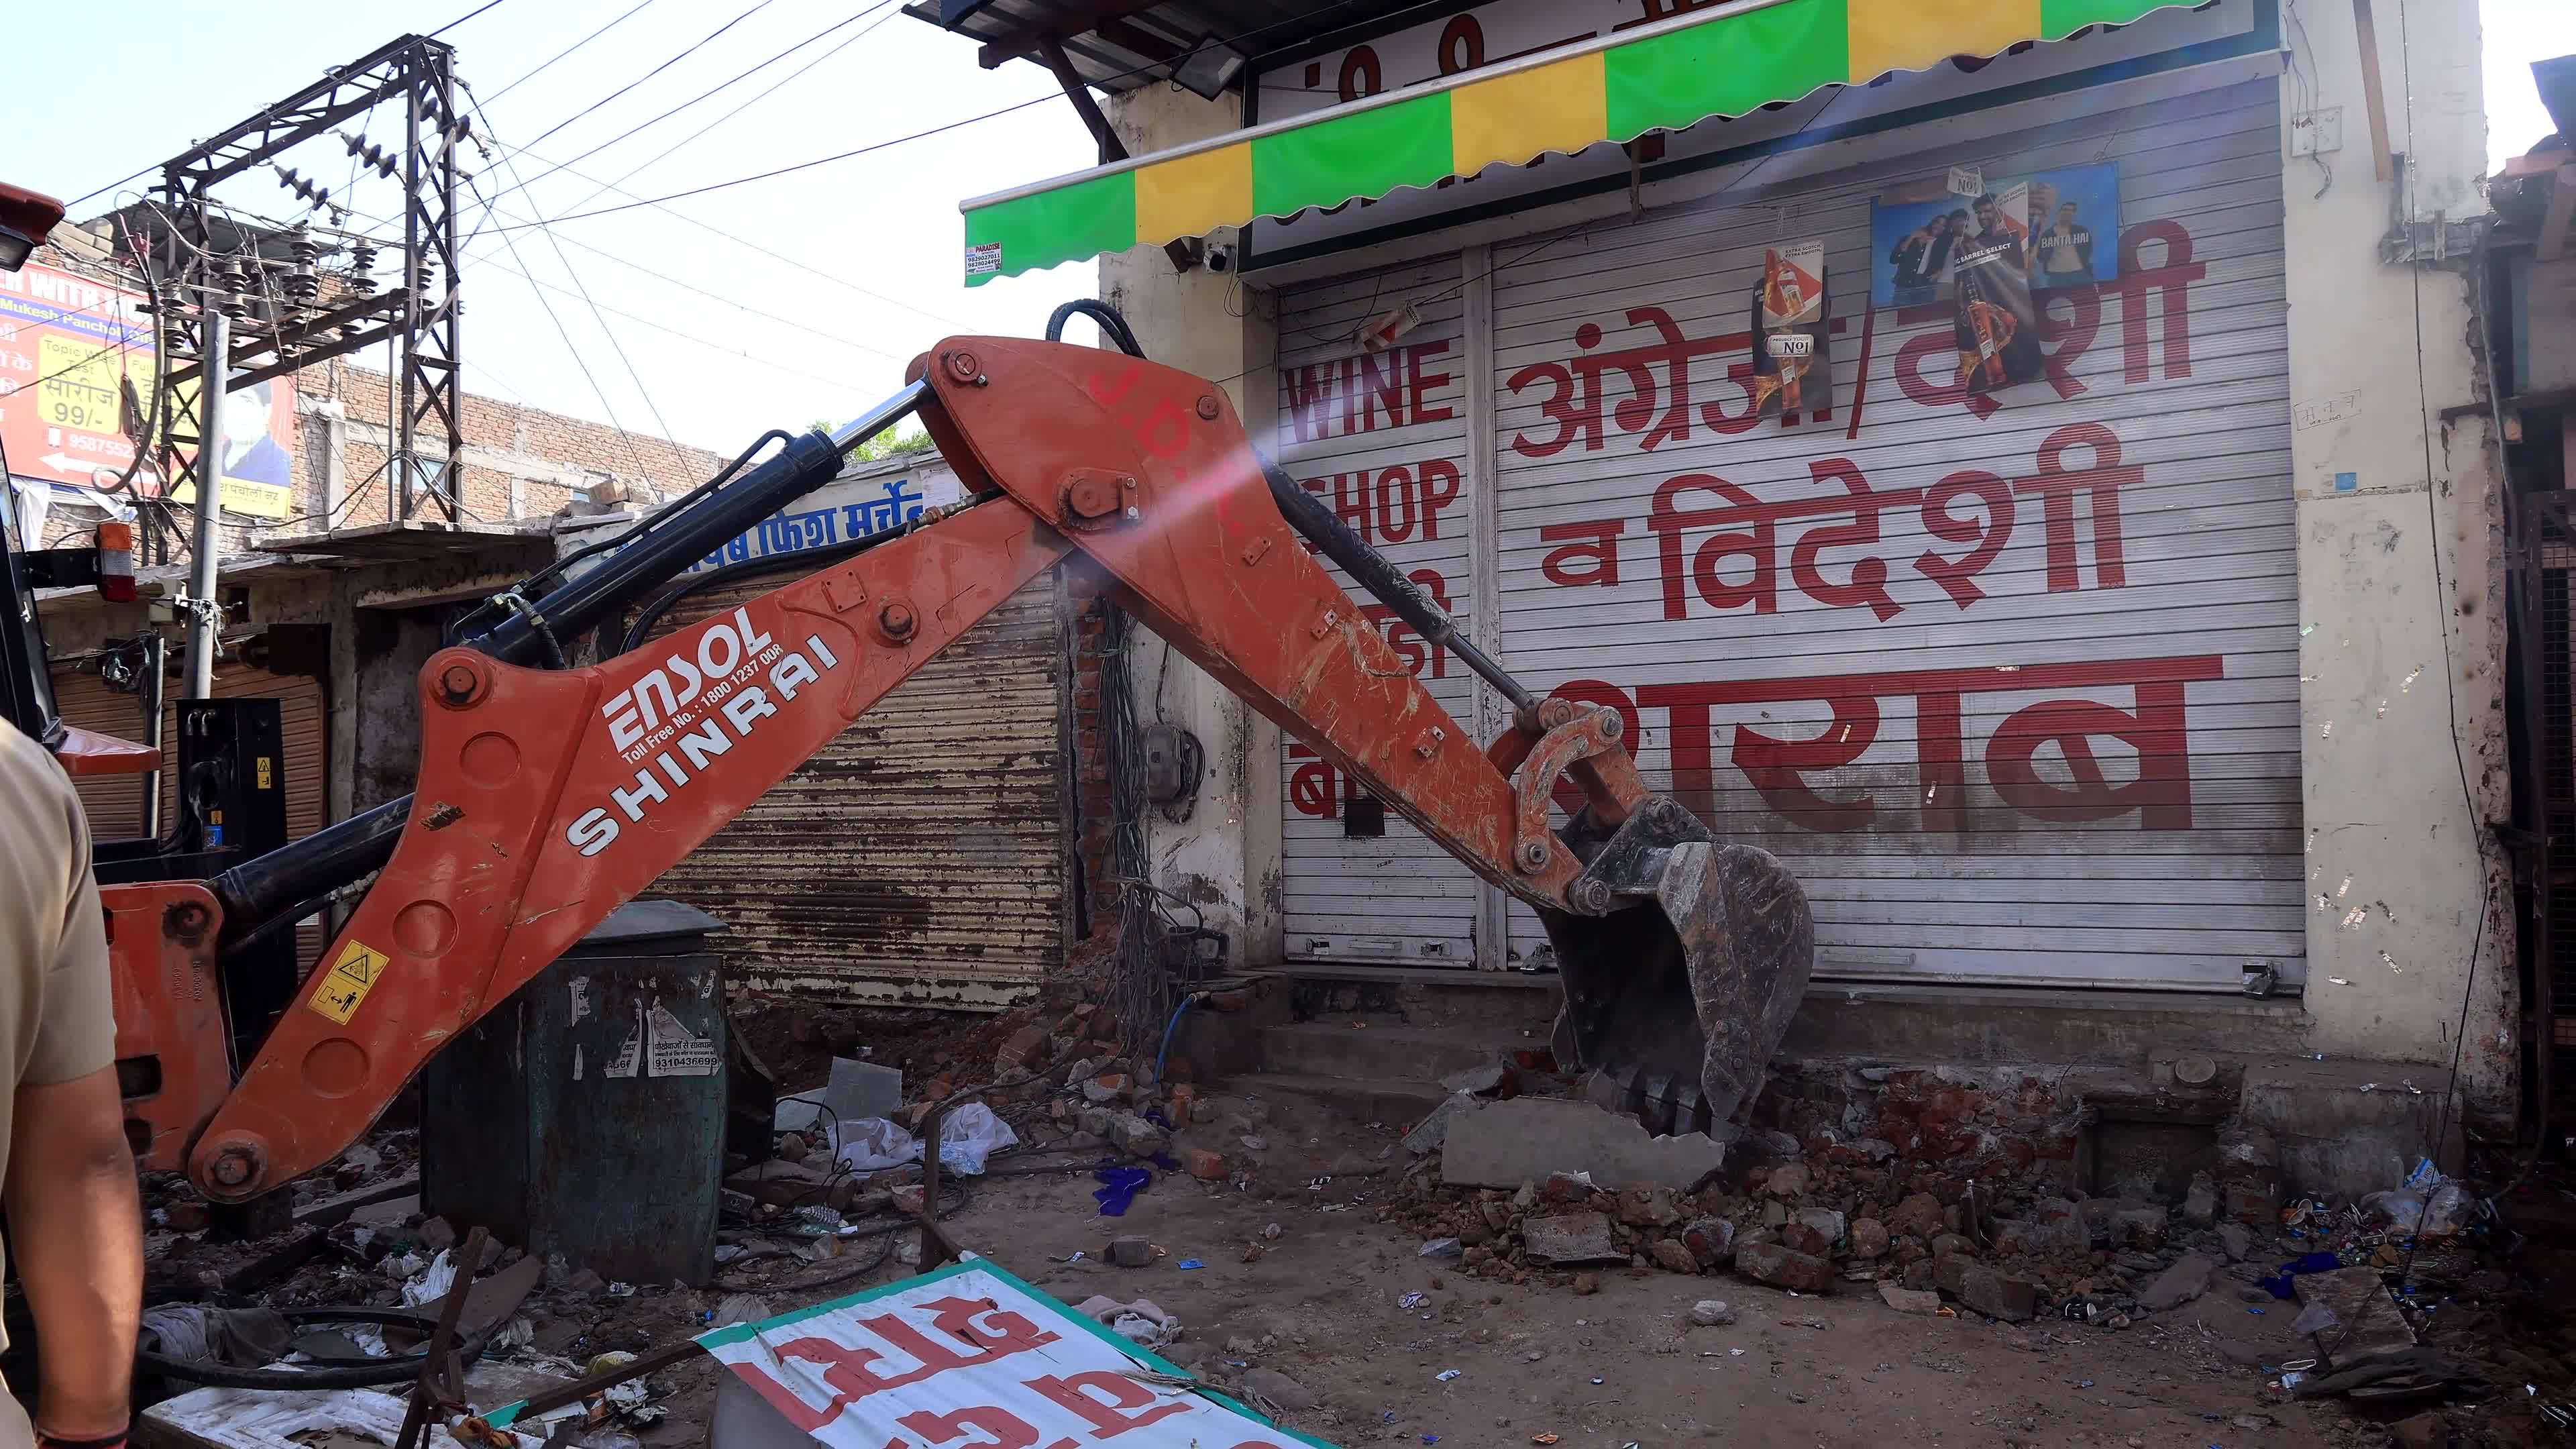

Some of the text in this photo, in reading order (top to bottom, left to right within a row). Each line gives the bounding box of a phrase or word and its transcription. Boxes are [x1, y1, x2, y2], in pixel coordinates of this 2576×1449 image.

[976, 243, 1000, 253] PARADISE
[2041, 231, 2089, 249] BANTA HAI
[968, 254, 1000, 262] 9829027011
[1961, 250, 1985, 262] BARREL
[1986, 242, 2012, 254] SELECT
[0, 299, 59, 323] Mukesh
[44, 339, 82, 356] Topic
[1284, 339, 1453, 443] WINE
[54, 402, 103, 427] 99/-
[1540, 422, 2144, 623] व विदेशी
[602, 606, 773, 753] ENSOL
[622, 743, 645, 765] Toll
[645, 725, 675, 750] Free
[701, 682, 731, 709] 1800
[731, 661, 761, 688] 1237
[759, 642, 784, 667] 008
[565, 633, 839, 857] SHINRAI
[683, 1040, 689, 1049] से
[655, 1057, 718, 1067] 9310436699
